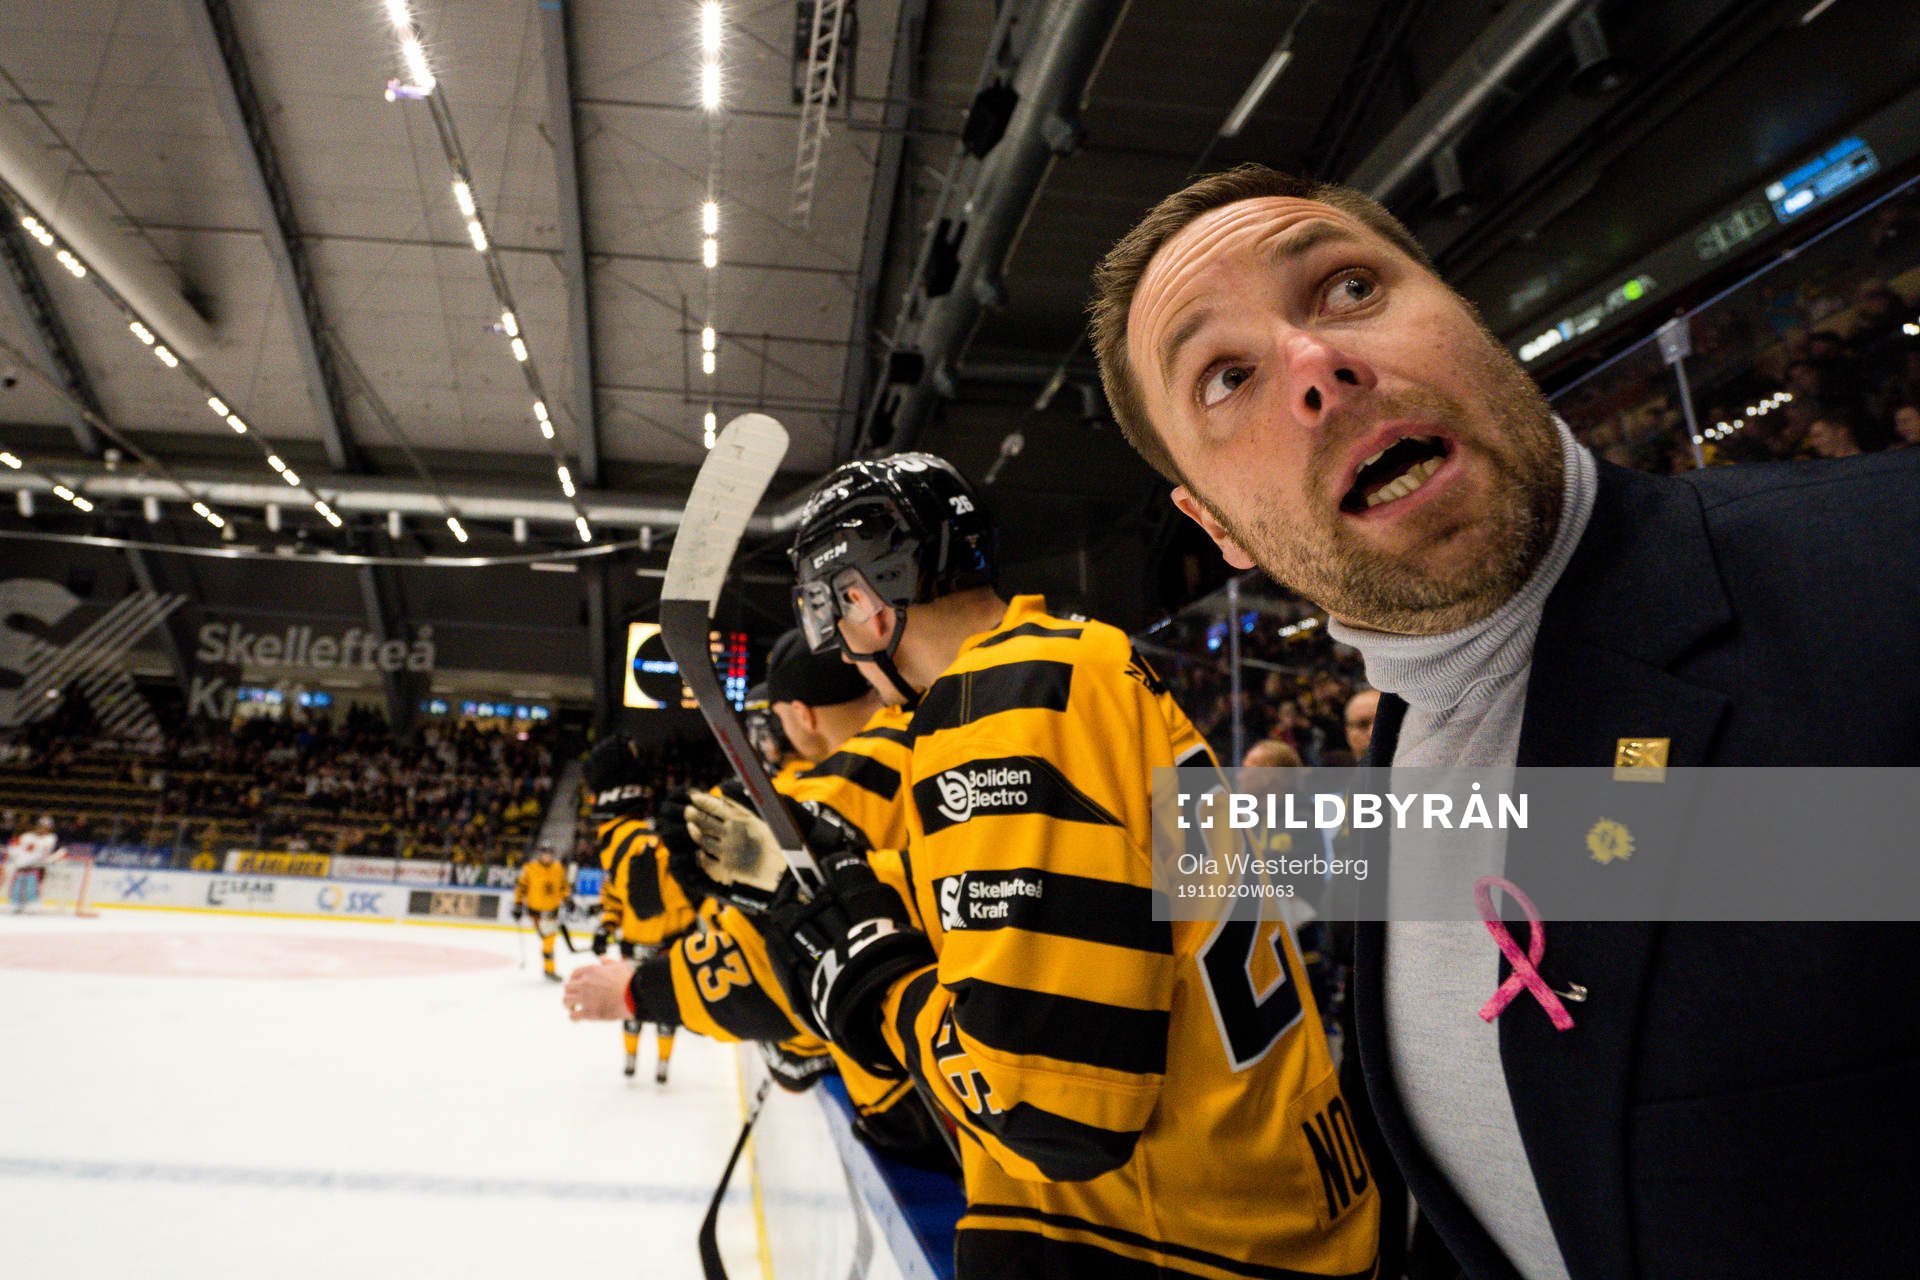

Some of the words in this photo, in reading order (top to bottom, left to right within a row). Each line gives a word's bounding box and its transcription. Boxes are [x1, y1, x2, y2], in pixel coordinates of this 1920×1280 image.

[949, 494, 975, 515] 26
[196, 622, 436, 672] Skellefteå
[969, 901, 1010, 919] Kraft
[684, 928, 752, 1003] 53
